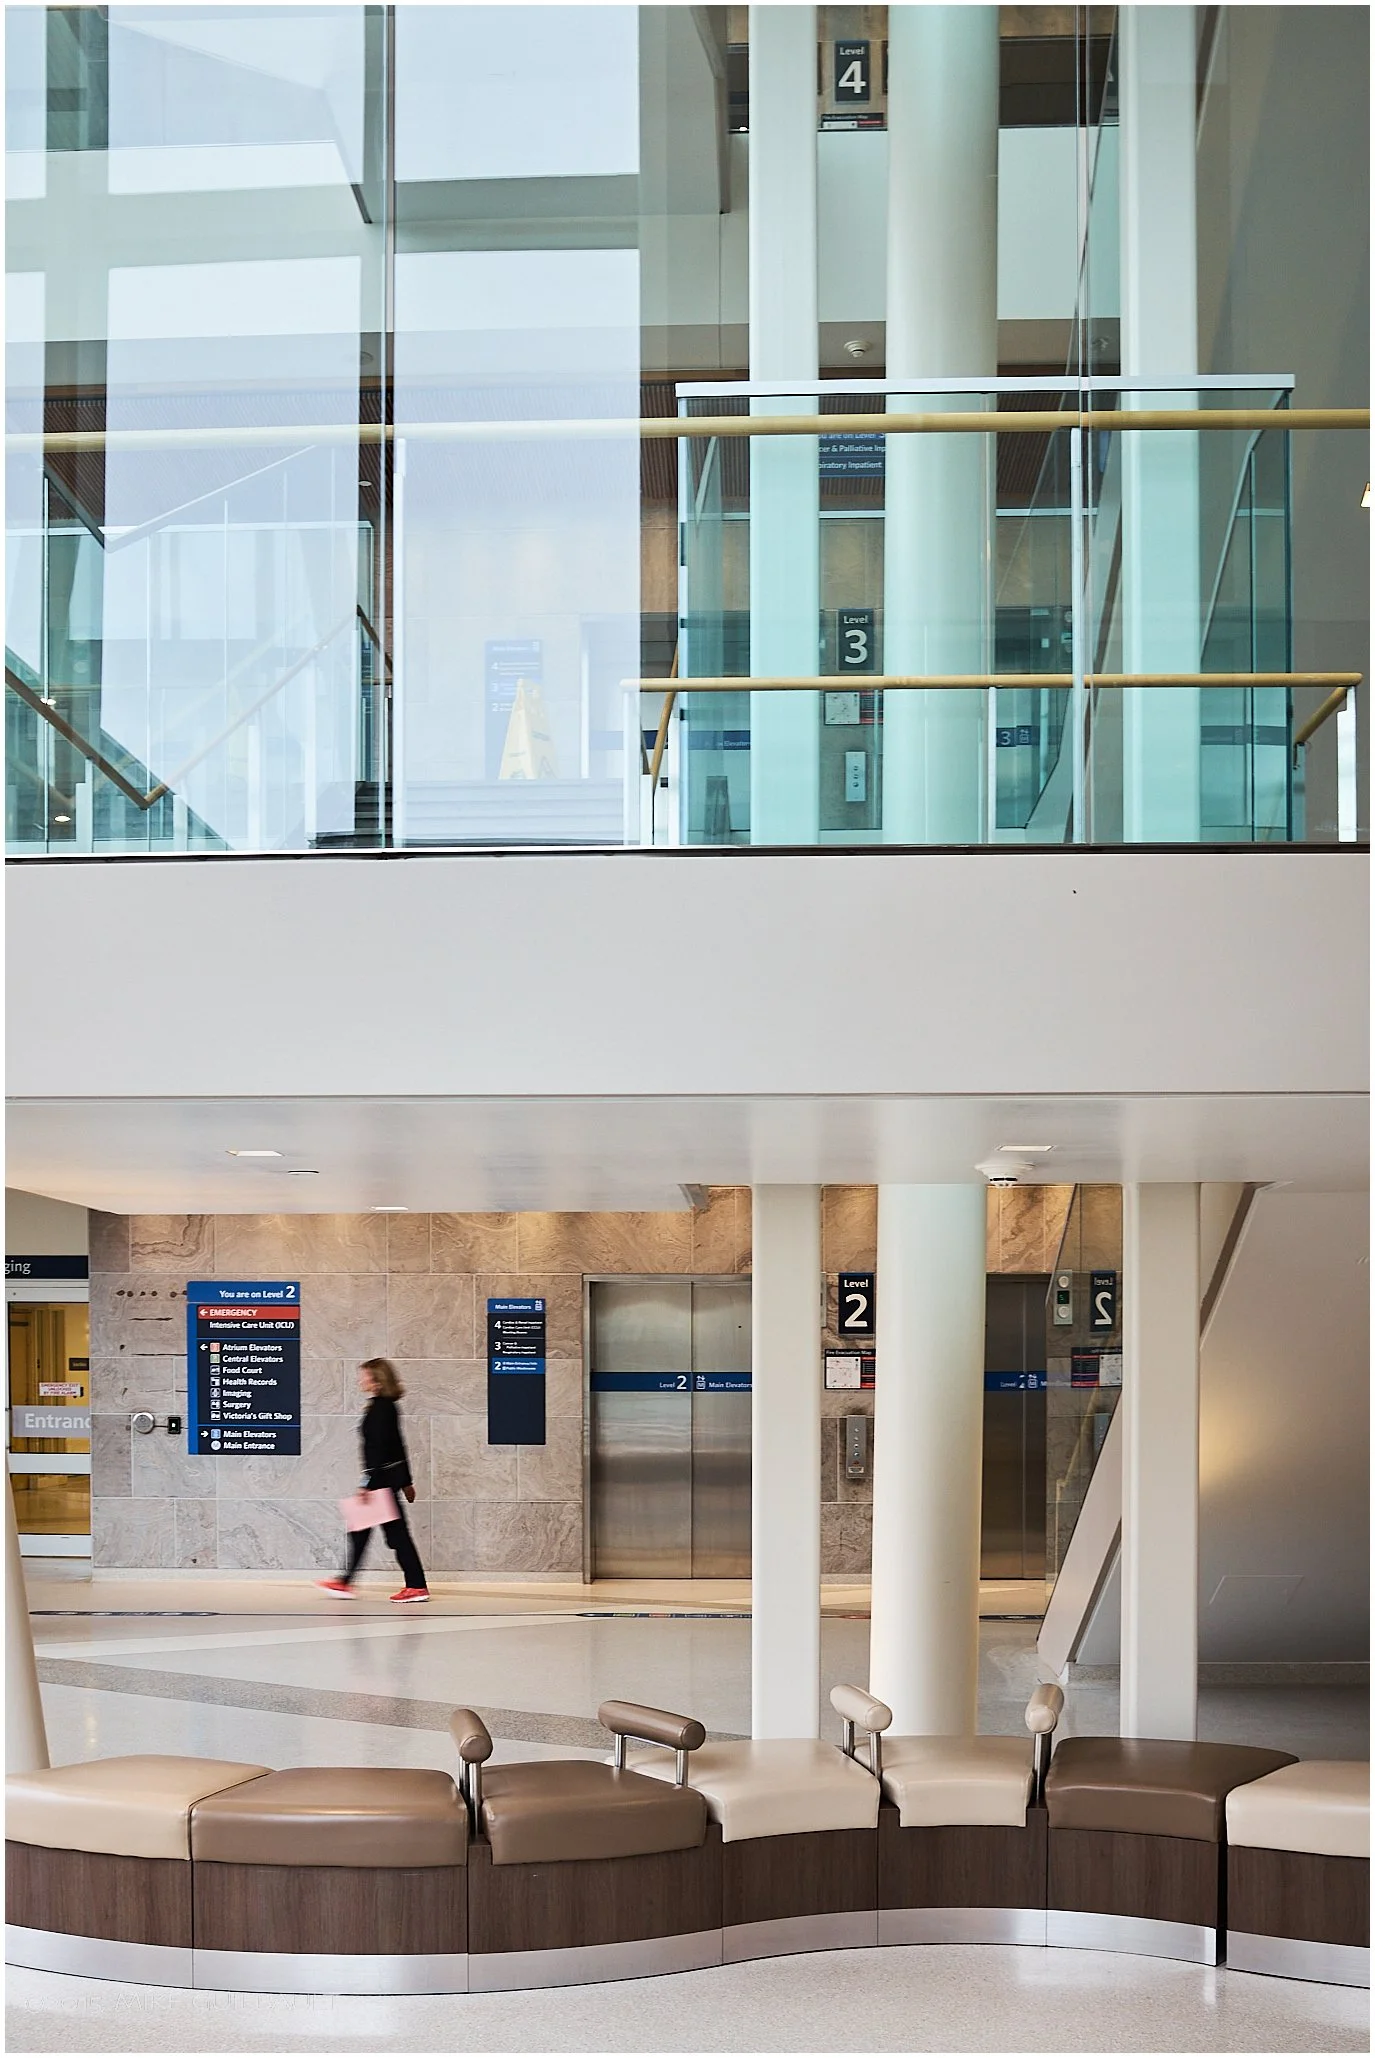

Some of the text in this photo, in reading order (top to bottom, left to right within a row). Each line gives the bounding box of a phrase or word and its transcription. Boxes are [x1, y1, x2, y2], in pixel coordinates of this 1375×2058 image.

[840, 47, 865, 55] Level
[838, 60, 867, 94] 4
[843, 615, 868, 624] Level
[844, 629, 868, 664] 3
[1000, 730, 1011, 746] 3
[844, 1279, 869, 1288] Level
[219, 1290, 235, 1298] You
[262, 1290, 284, 1298] Level
[285, 1285, 296, 1298] 2
[209, 1309, 258, 1317] EMERGENCY
[844, 1293, 868, 1328] 2
[209, 1321, 295, 1330] Intensive Care Unit (ICU)
[494, 1320, 502, 1329] 4
[222, 1343, 283, 1351] Atrium Elevators
[494, 1341, 502, 1351] 3
[222, 1355, 284, 1363] Central Elevators
[222, 1366, 263, 1374] Food Court
[494, 1361, 502, 1371] 2
[222, 1378, 278, 1386] Health Records
[676, 1375, 687, 1390] 2
[222, 1390, 252, 1398] Imaging
[222, 1401, 251, 1409] Surgery
[222, 1412, 293, 1421] Victoria's Gift Shop
[223, 1430, 277, 1438] Main Elevators
[223, 1442, 276, 1450] Main Entrance
